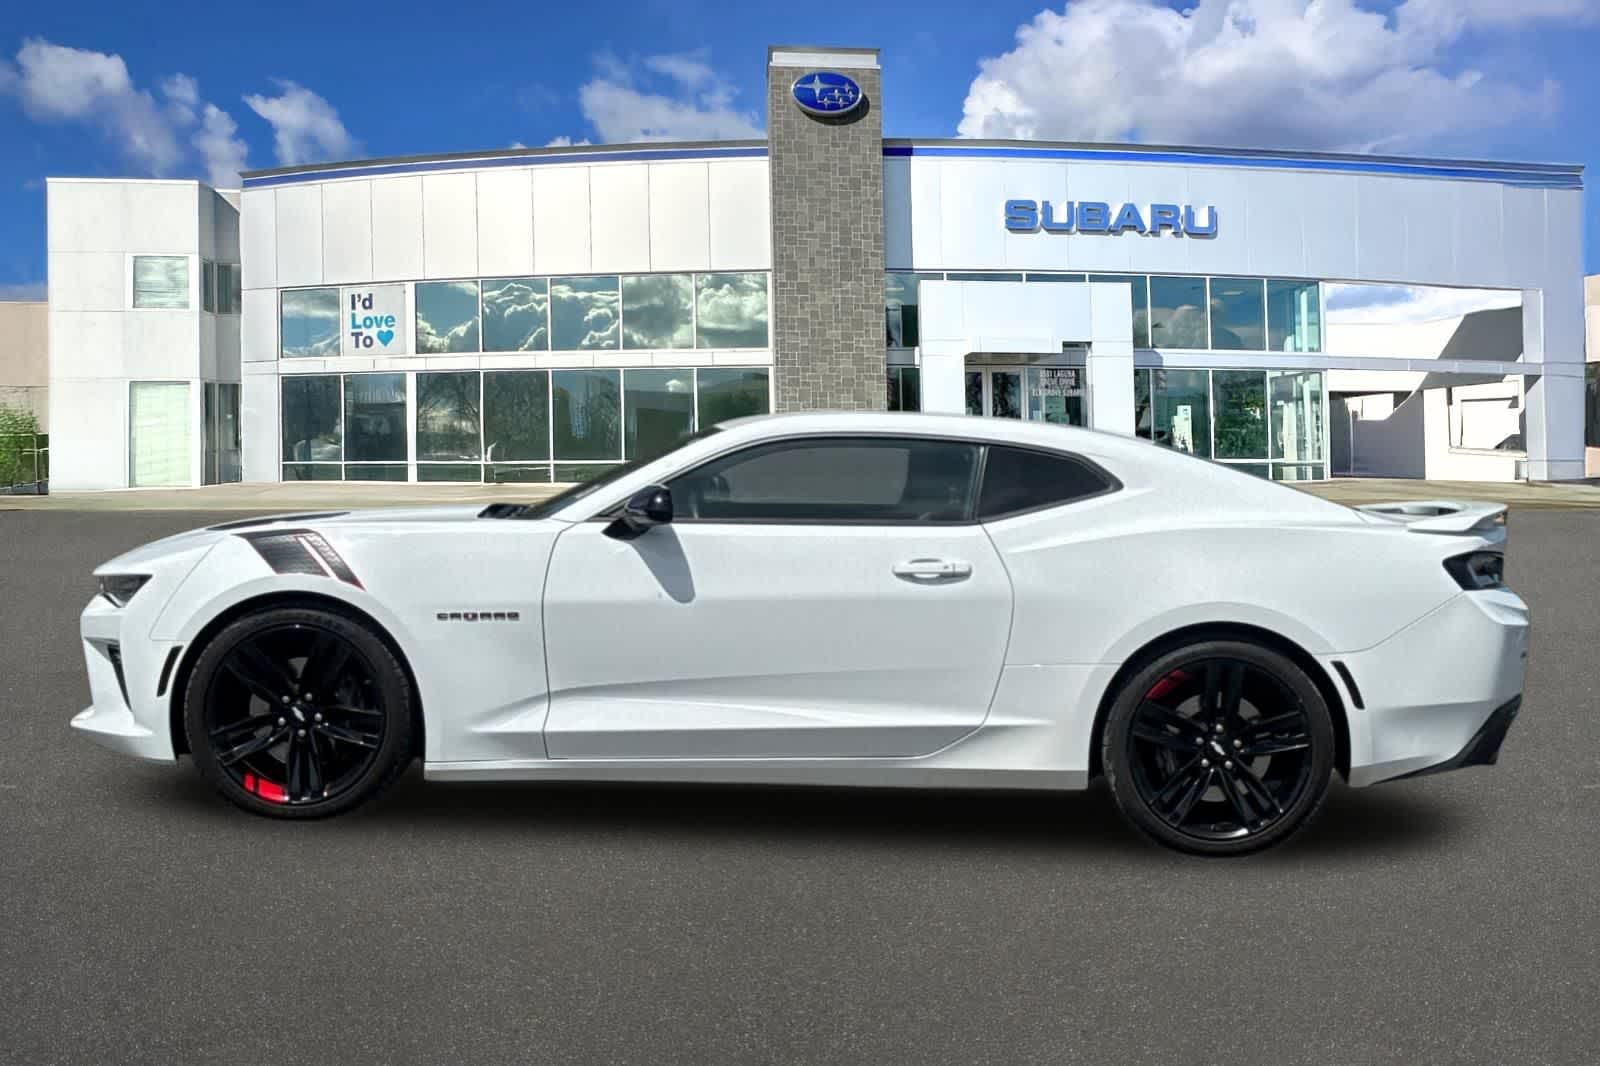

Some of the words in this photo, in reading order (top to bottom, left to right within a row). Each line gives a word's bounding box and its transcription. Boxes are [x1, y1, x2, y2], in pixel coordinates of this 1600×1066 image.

[1005, 199, 1217, 239] SUBARU
[351, 293, 373, 310] I'd
[351, 313, 396, 329] Love
[351, 331, 374, 348] To
